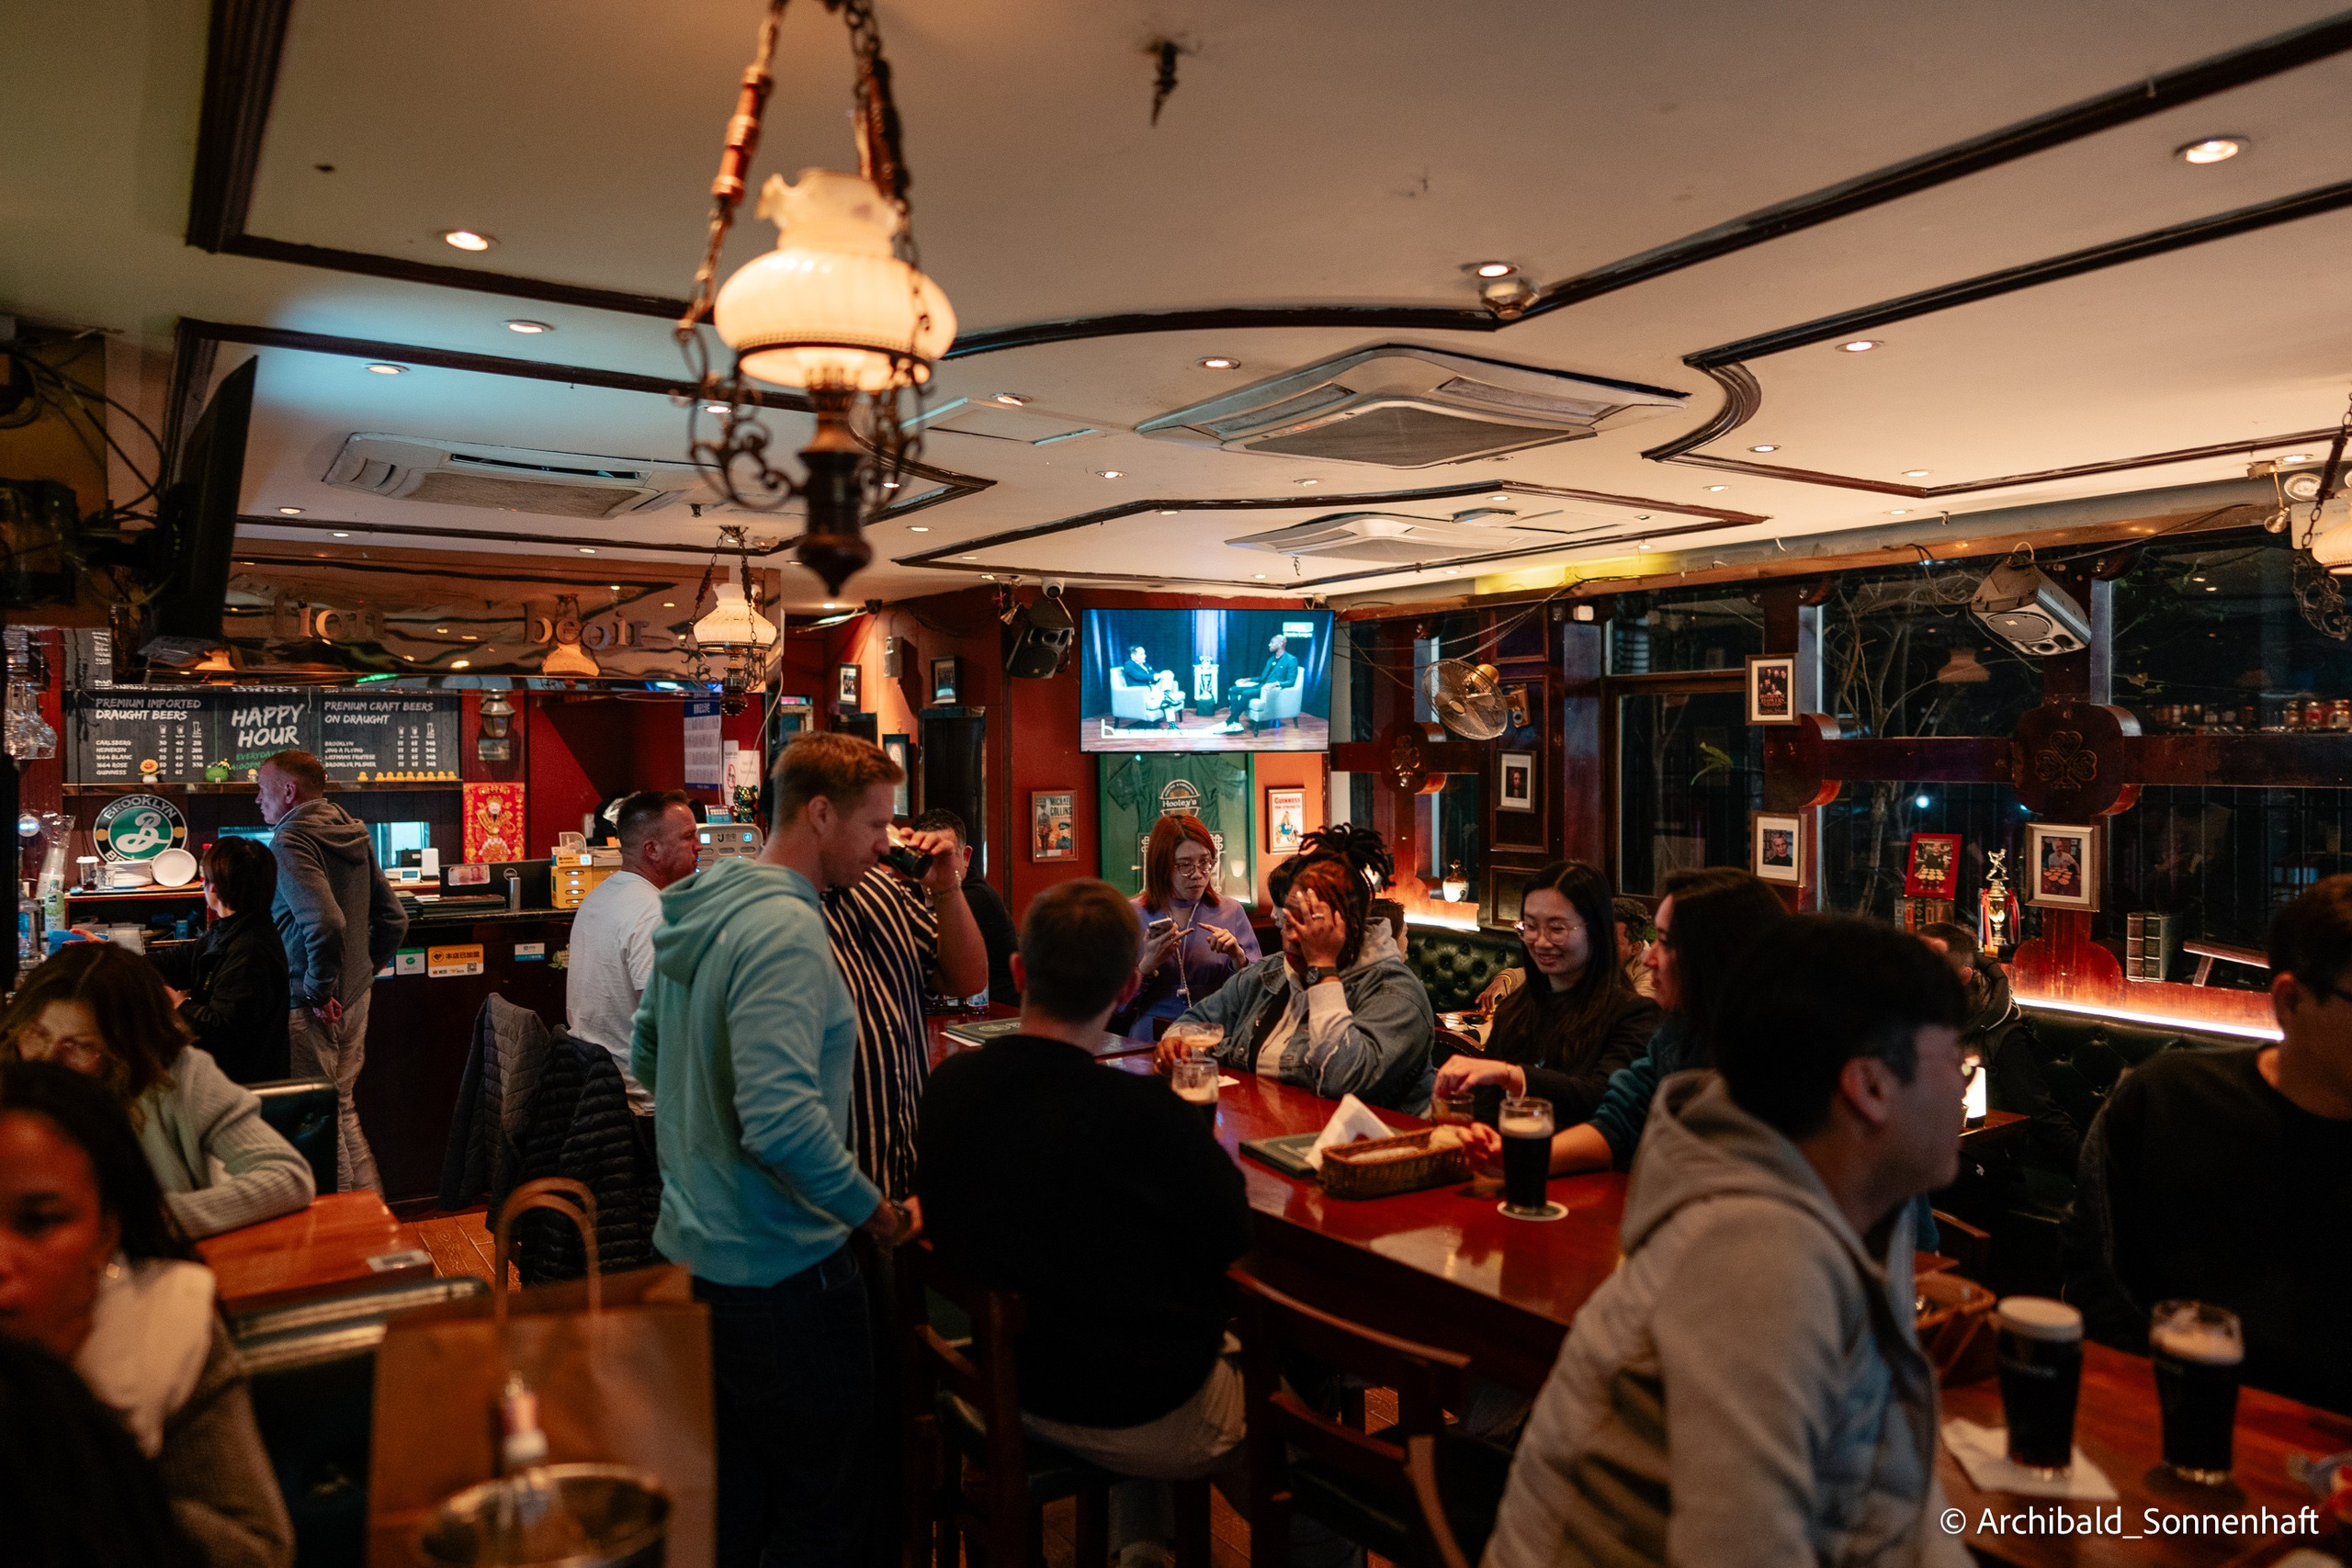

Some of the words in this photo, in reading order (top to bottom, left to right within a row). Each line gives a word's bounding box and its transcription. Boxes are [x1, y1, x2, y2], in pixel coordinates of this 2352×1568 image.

[96, 698, 144, 709] PREMIUM
[147, 698, 201, 709] IMPORTED
[324, 701, 368, 711] PREMIUM
[369, 701, 401, 711] CRAFT
[402, 702, 434, 712] BEERS
[96, 709, 150, 720] DRAUGHT
[152, 710, 187, 721] BEERS
[231, 703, 305, 728] HAPPY
[324, 715, 341, 724] ON
[343, 715, 390, 725] DRAUGHT
[237, 725, 300, 749] HOUR
[103, 796, 177, 820] BROOKLYN
[1162, 798, 1198, 807] Hooley's
